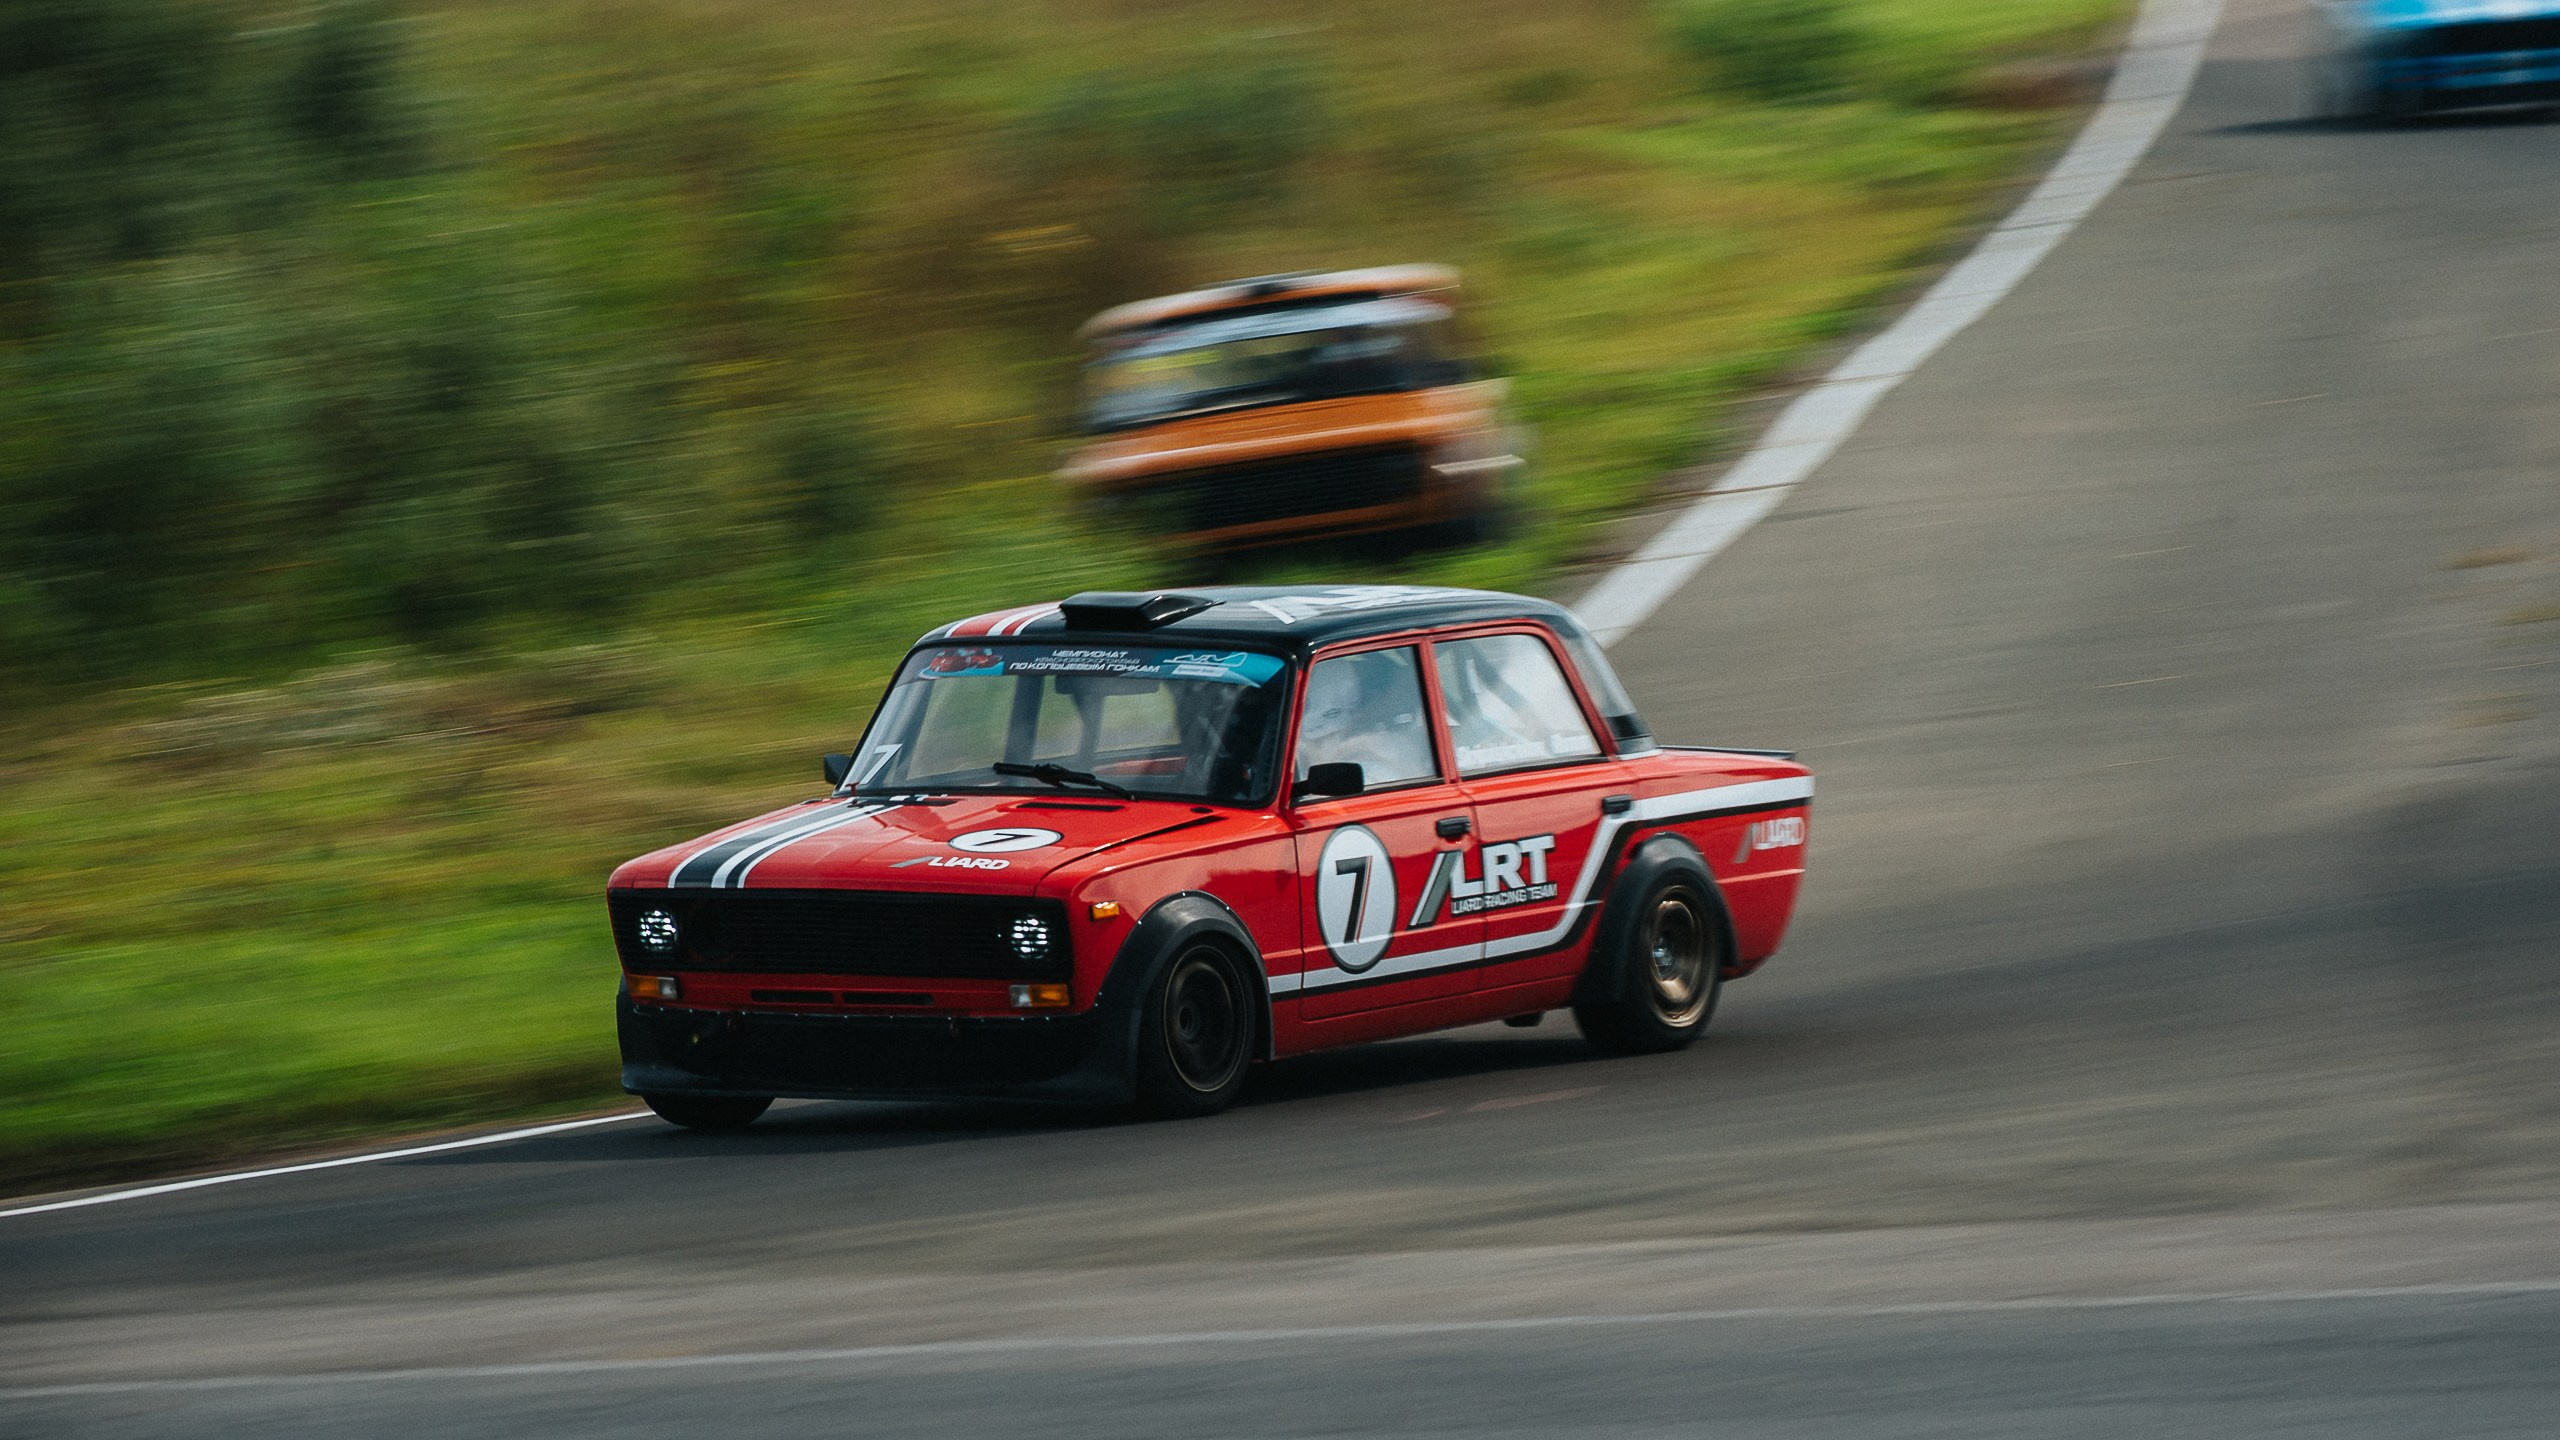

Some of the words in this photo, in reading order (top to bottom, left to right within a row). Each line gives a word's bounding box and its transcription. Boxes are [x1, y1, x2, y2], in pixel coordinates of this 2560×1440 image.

[1052, 649, 1128, 659] ЧЕМПИОНАТ
[1009, 661, 1029, 670] ПО
[1026, 662, 1106, 671] КОЛЬЦЕВЫМ
[1105, 664, 1161, 673] ГОНКАМ
[859, 743, 904, 785] 7
[971, 832, 1038, 847] 7
[927, 856, 1011, 871] LIARD
[1335, 855, 1373, 944] 7
[1451, 897, 1484, 915] LIARD
[1484, 888, 1528, 908] RACING
[1526, 882, 1558, 902] TEAM
